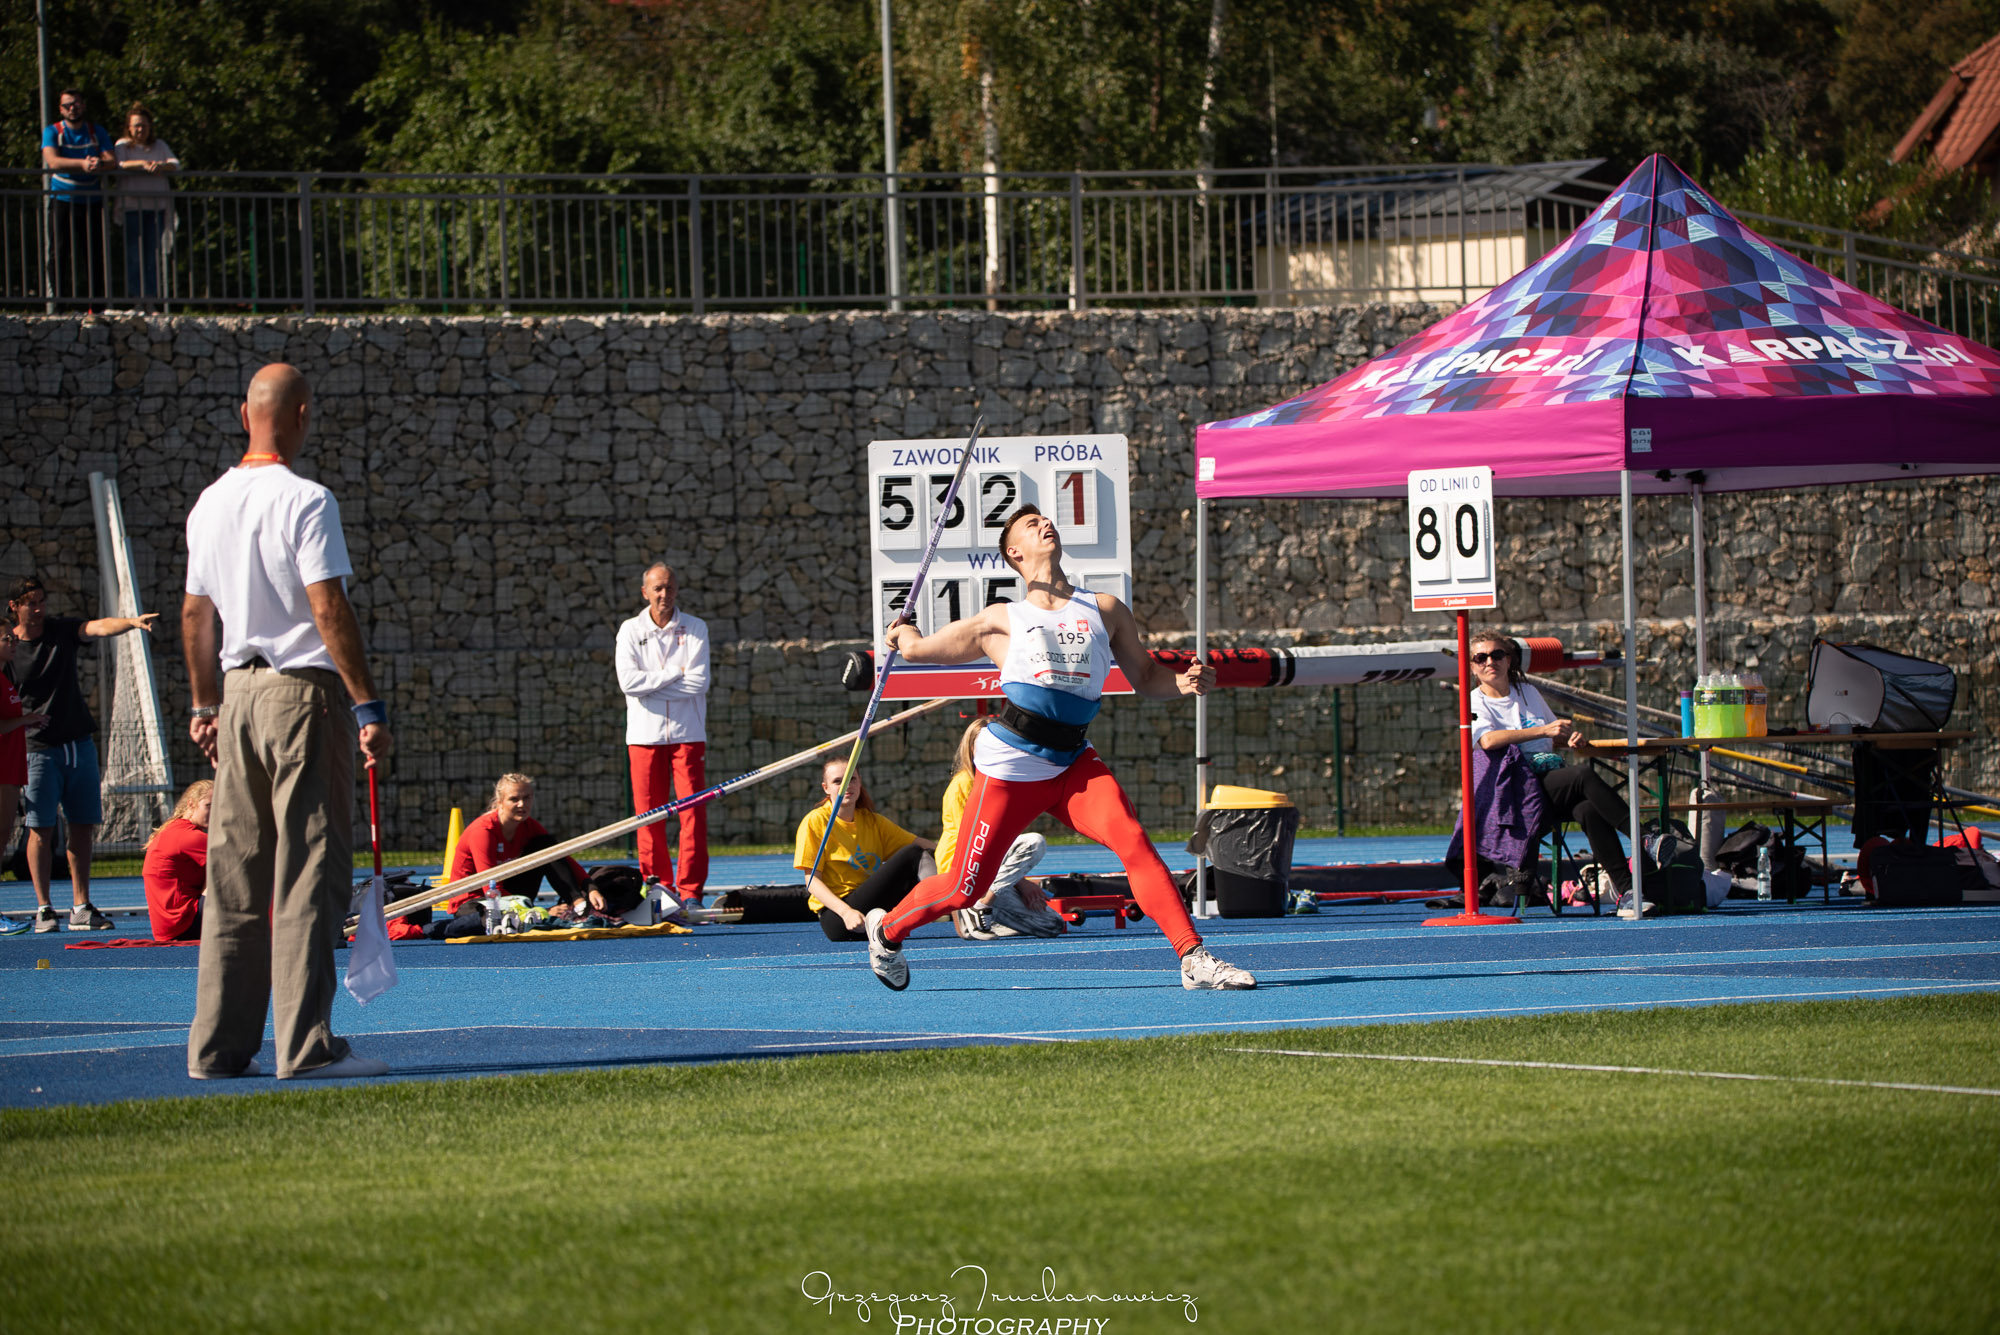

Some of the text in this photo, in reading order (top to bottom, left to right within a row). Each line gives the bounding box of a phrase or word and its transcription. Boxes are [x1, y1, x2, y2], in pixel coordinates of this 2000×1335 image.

[1671, 335, 1974, 367] KARPACZ.pl
[1347, 348, 1604, 391] KARPACZ.pl
[892, 446, 1001, 467] ZAWODNIK
[1034, 440, 1103, 463] PRÓBA
[1420, 476, 1480, 492] OD LINII 0
[1060, 471, 1086, 526] 1
[1057, 632, 1086, 645] 195
[960, 820, 991, 897] POLSKA
